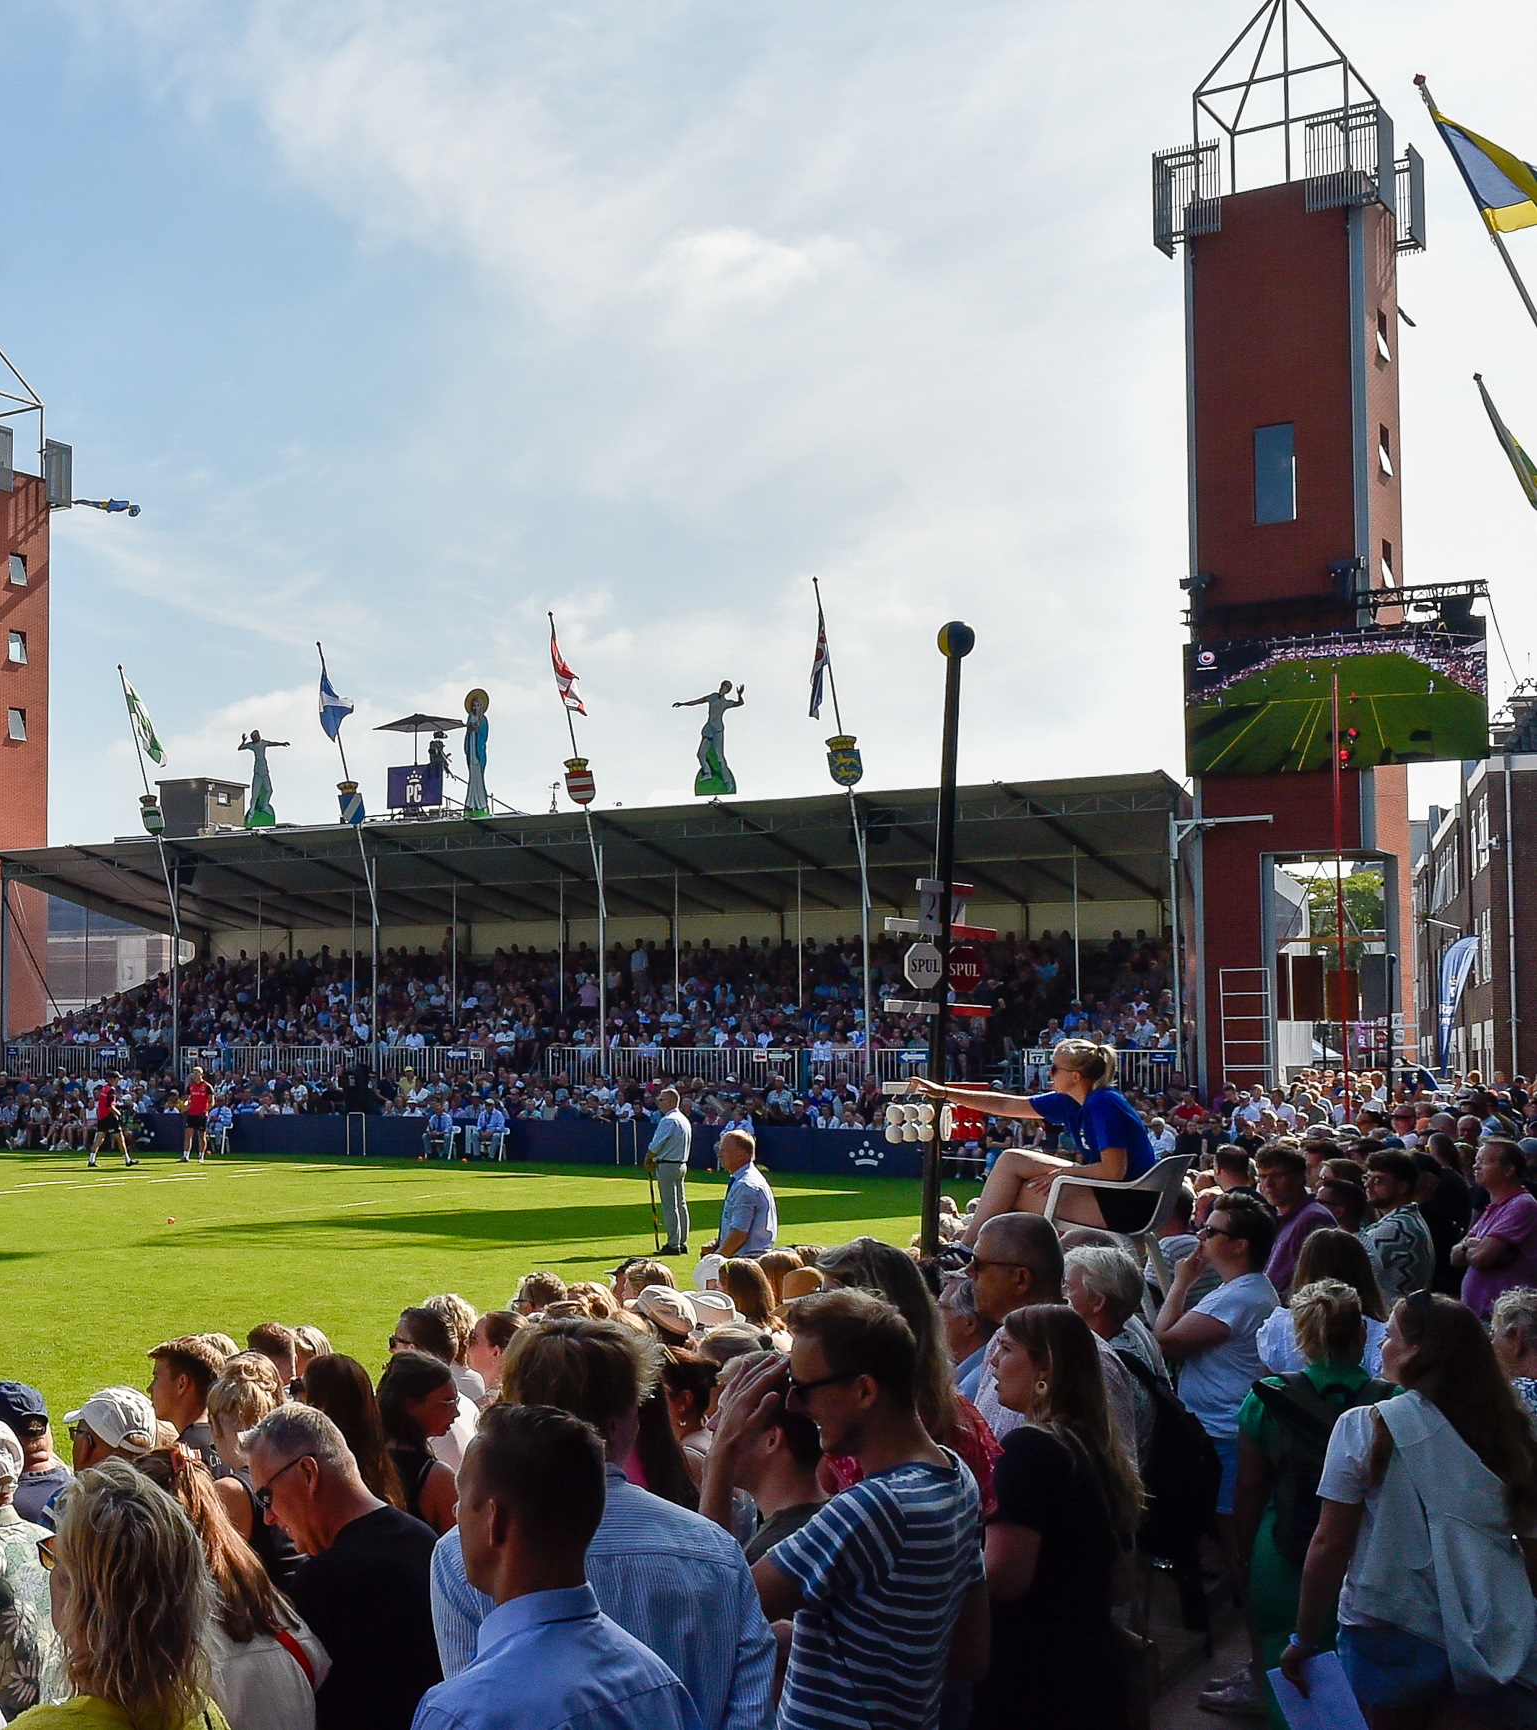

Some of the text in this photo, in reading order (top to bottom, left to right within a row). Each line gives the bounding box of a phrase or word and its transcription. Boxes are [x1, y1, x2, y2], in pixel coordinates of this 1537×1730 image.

[406, 784, 423, 804] PC
[911, 958, 941, 973] SPUL
[949, 963, 980, 977] SPUL
[1032, 1055, 1043, 1063] 17
